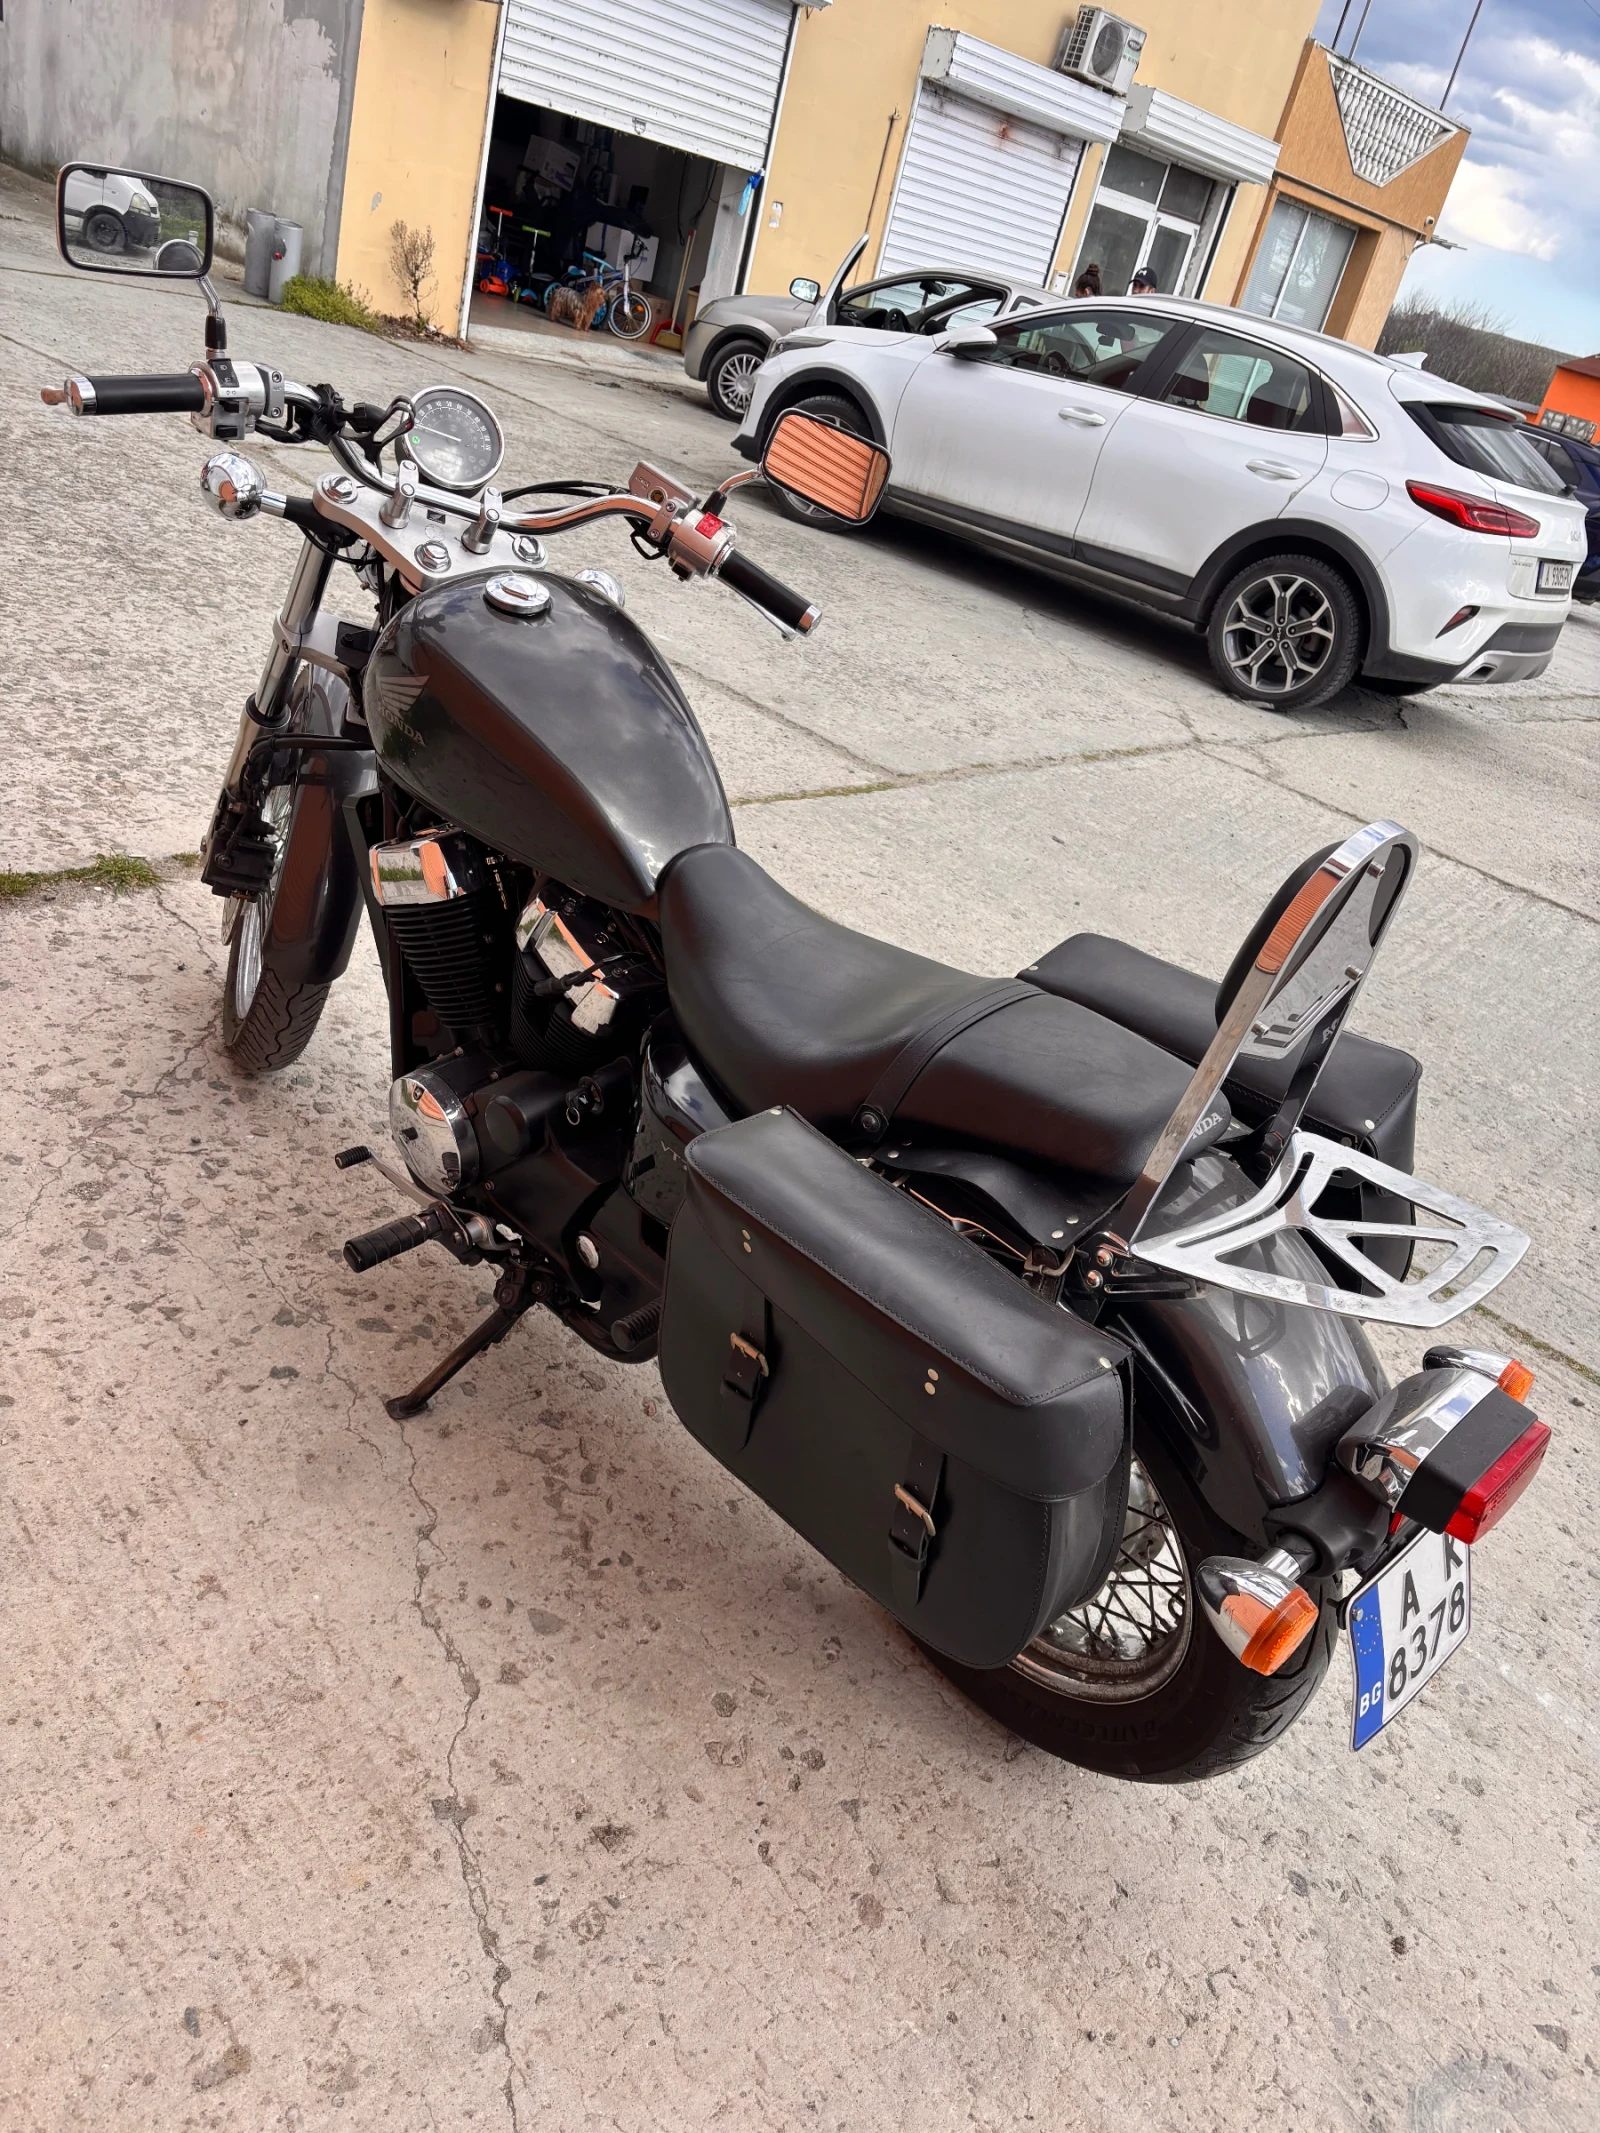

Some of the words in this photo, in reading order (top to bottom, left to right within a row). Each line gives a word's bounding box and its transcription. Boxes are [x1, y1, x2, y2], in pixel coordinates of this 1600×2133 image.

[379, 703, 428, 749] HONDA
[1191, 1111, 1224, 1140] NDA
[1400, 1568, 1421, 1631] A
[1442, 1531, 1464, 1582] K
[1388, 1581, 1466, 1701] 8378
[1359, 1681, 1383, 1719] BG
